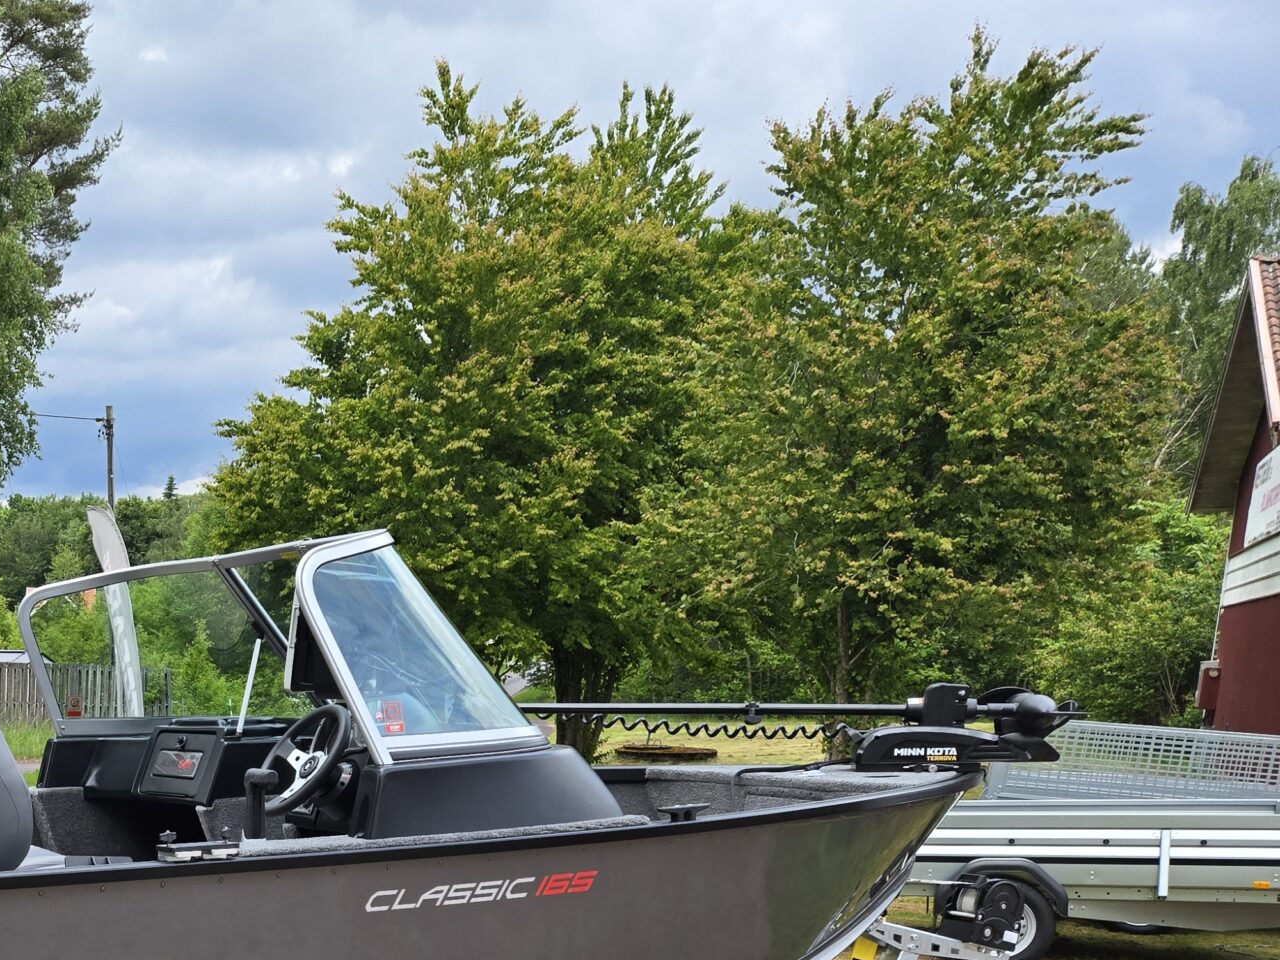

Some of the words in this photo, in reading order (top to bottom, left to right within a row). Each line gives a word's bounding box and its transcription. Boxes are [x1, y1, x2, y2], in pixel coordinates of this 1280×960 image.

[893, 747, 925, 756] MINN
[926, 747, 957, 756] KOTA
[364, 876, 536, 912] CLASSIC
[535, 870, 598, 896] 165
